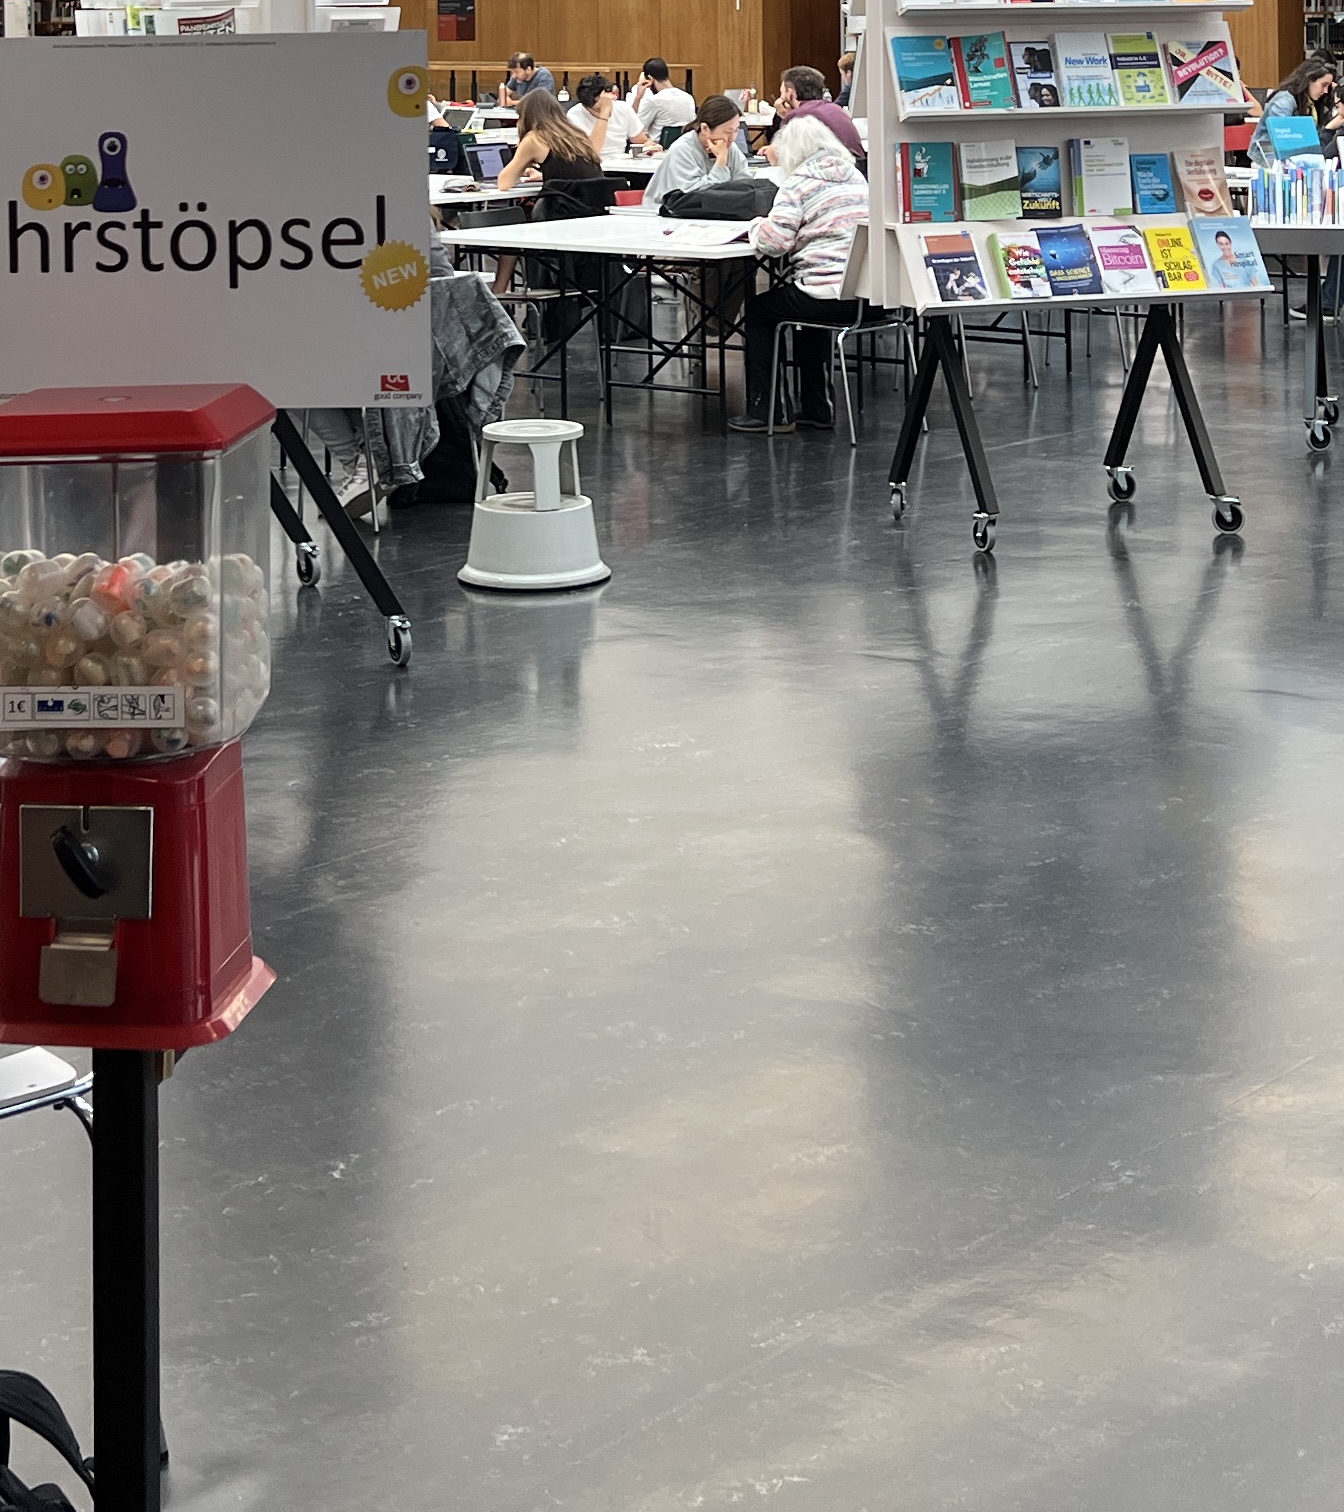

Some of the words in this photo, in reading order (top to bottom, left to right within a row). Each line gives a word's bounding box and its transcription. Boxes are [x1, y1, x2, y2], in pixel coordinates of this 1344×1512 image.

[1064, 56, 1084, 66] New
[1085, 55, 1108, 66] Work
[1177, 47, 1224, 78] REVOLUTION?
[1206, 68, 1233, 89] BITTE!
[1022, 200, 1061, 210] Zukunft
[1157, 238, 1184, 248] ONLINE
[1102, 253, 1145, 266] Bitcoin
[1160, 249, 1172, 259] IST
[1233, 251, 1255, 259] Smart
[1229, 258, 1259, 269] Hospital
[371, 261, 418, 290] NEW
[1168, 271, 1184, 282] BAR
[373, 393, 392, 401] good
[8, 699, 26, 714] 1€
